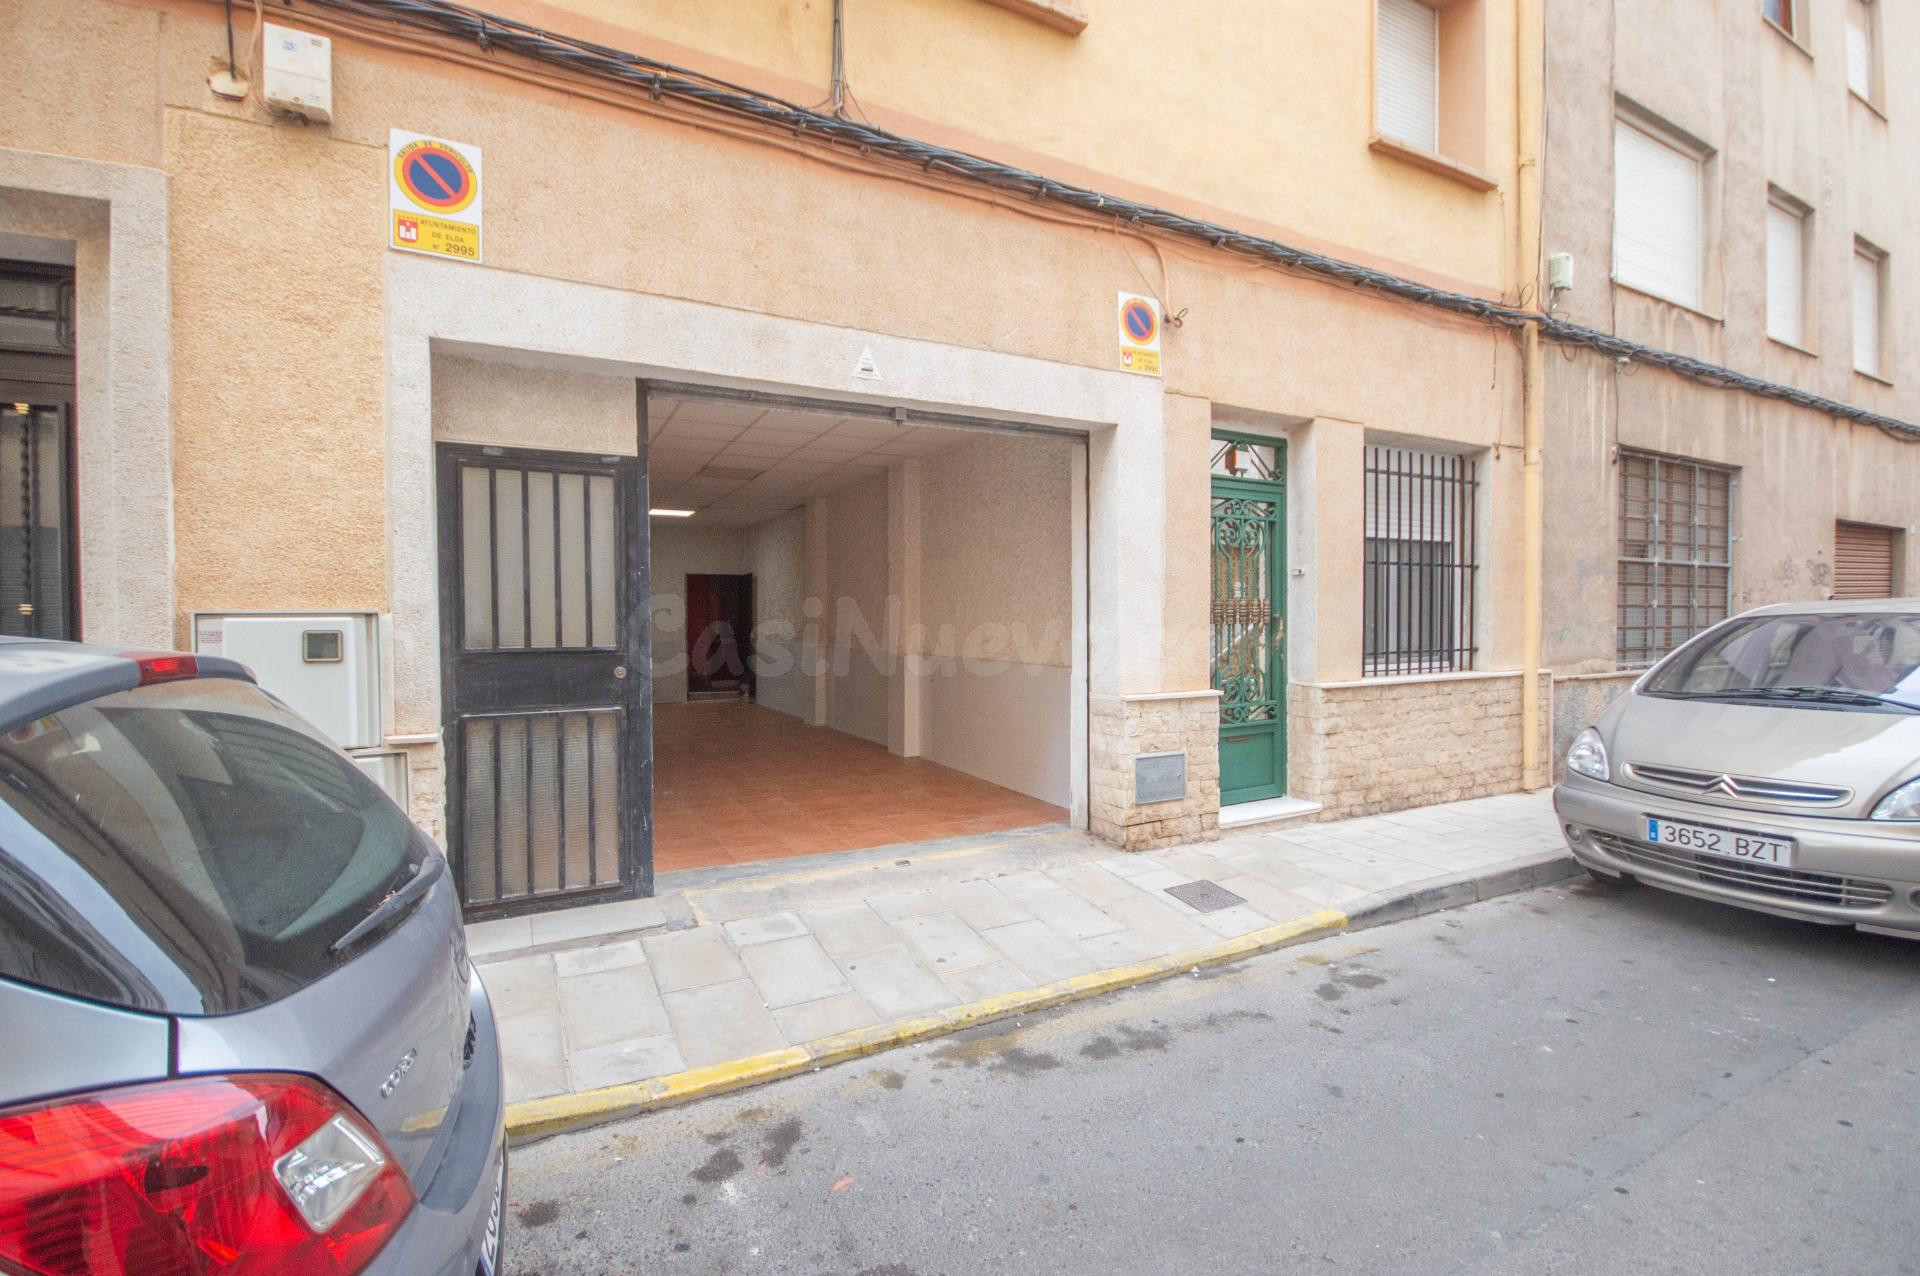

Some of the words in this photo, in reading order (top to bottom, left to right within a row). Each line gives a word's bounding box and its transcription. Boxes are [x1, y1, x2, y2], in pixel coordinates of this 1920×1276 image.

[420, 219, 477, 235] AYUNTAMIENTO
[431, 231, 443, 240] DE
[445, 234, 465, 244] ELDA
[445, 242, 476, 257] 2995
[1664, 825, 1722, 852] 3652
[1735, 837, 1783, 862] BZT
